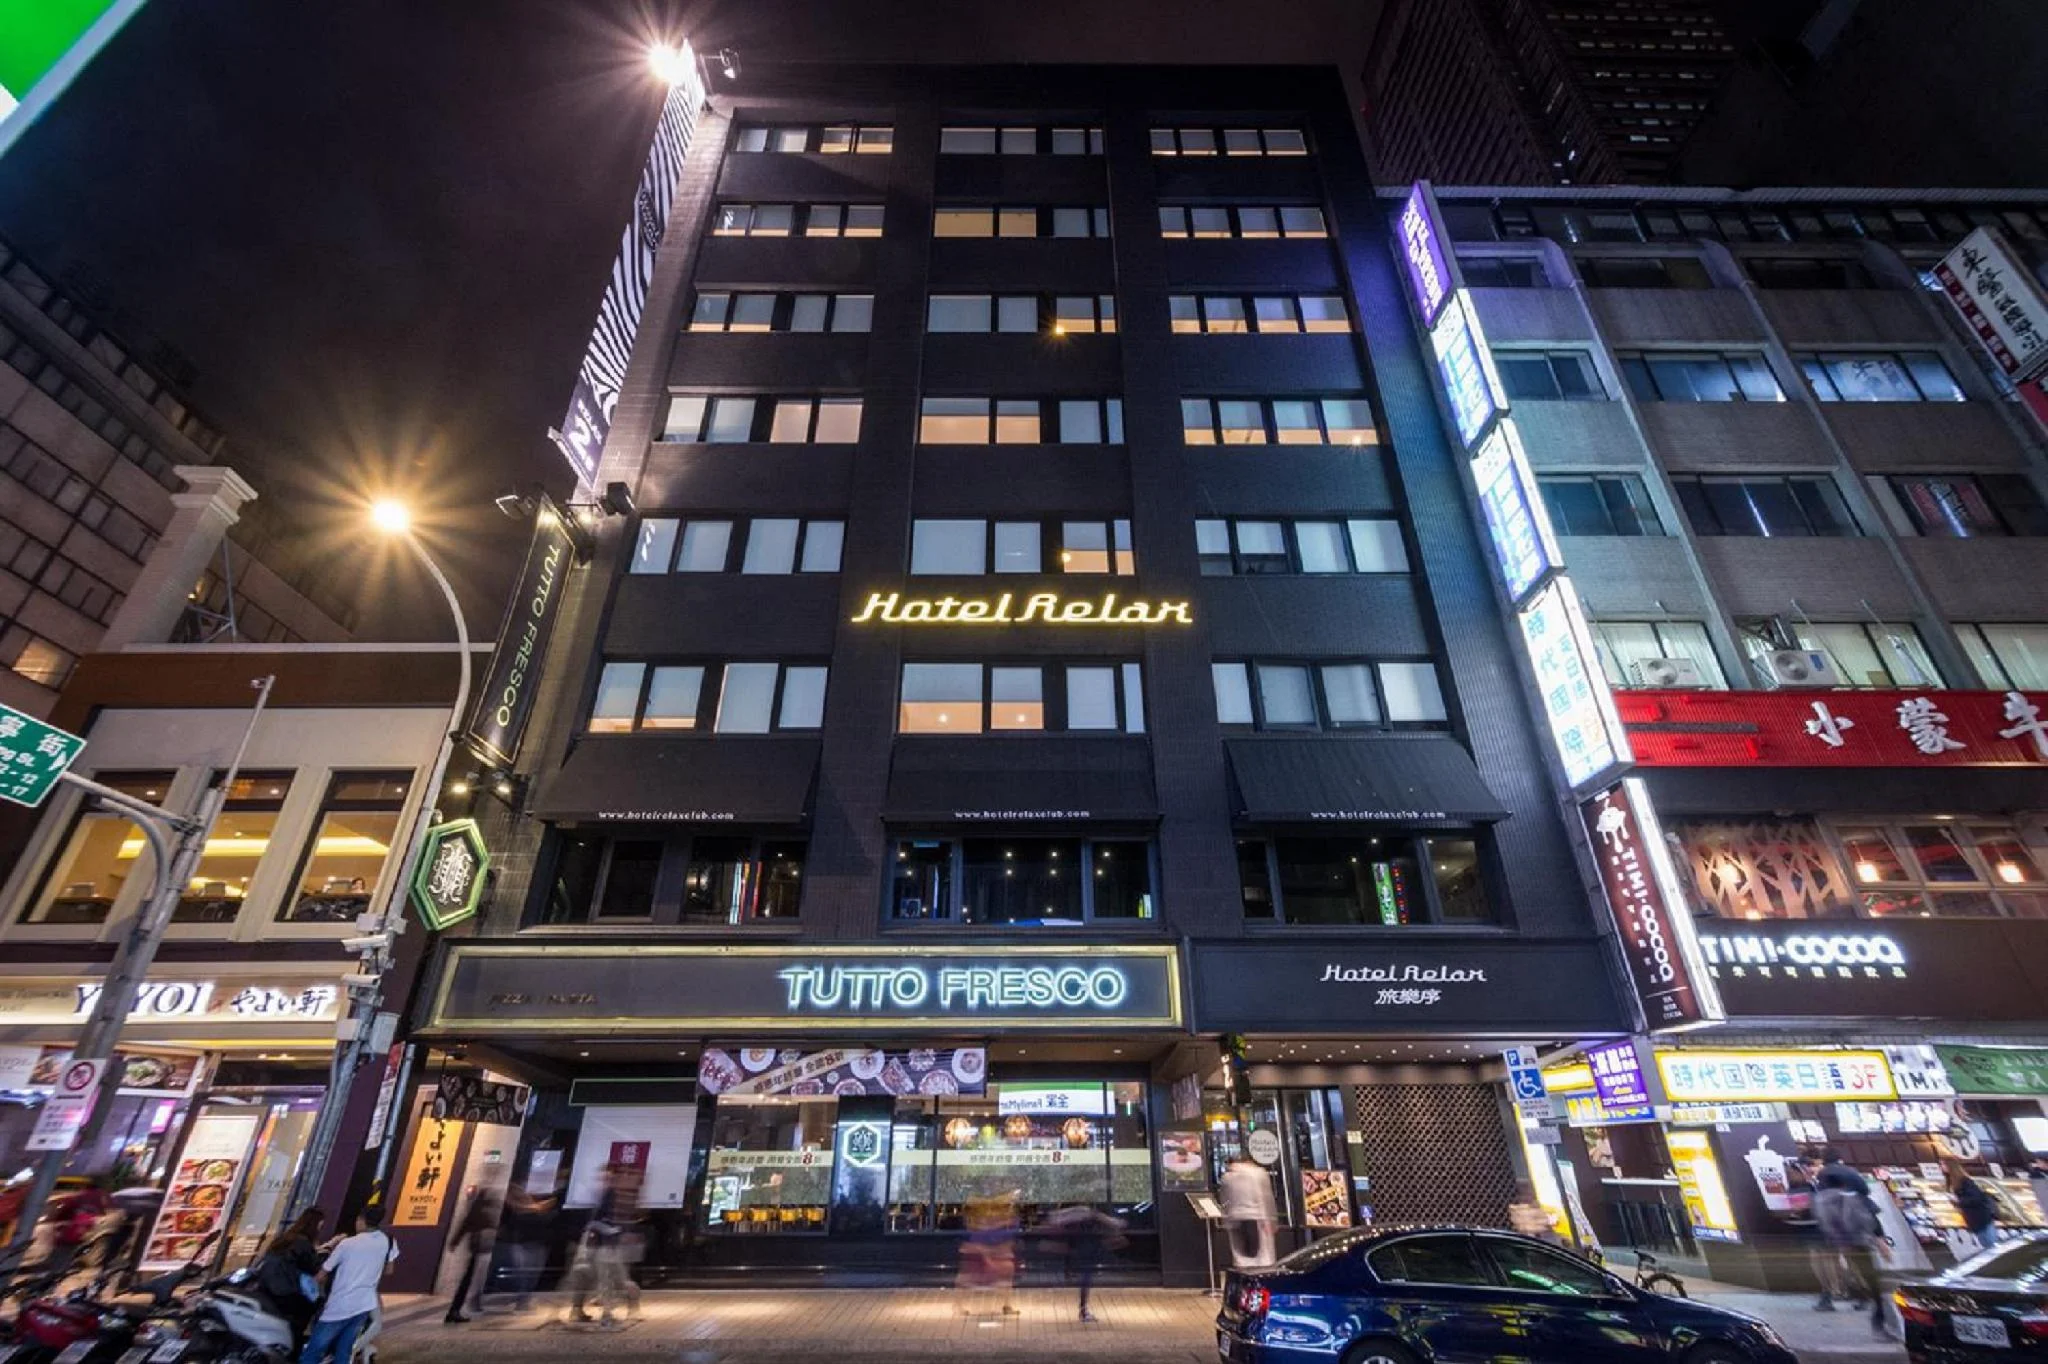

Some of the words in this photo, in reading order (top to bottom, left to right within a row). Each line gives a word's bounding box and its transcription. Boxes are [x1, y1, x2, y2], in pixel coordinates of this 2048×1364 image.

[531, 544, 561, 618] TUTTO
[851, 592, 1012, 624] Hotel
[1014, 592, 1193, 624] Relax
[496, 620, 539, 728] FRESCO
[780, 967, 927, 1007] TUTTO
[940, 966, 1126, 1007] FRESCO
[1319, 963, 1398, 982] Hotel
[1399, 963, 1488, 982] Relax
[73, 984, 206, 1015] YYOI
[229, 986, 331, 1017] やよい軒
